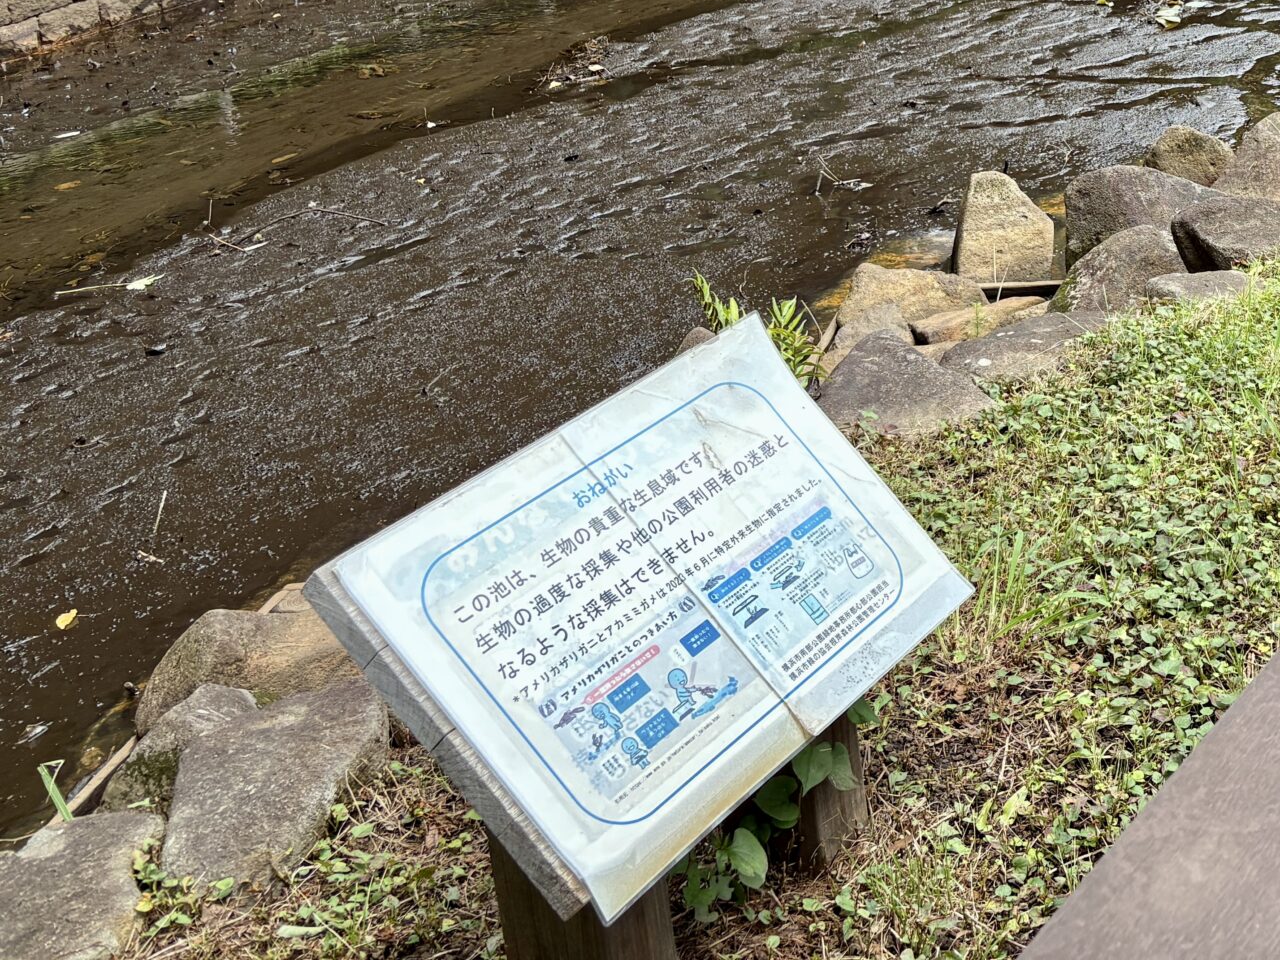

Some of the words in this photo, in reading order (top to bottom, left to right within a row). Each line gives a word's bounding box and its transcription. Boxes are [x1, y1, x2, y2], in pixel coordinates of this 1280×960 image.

[450, 445, 710, 630] この池は、生物の貴重な生息域です
[472, 428, 790, 659] 生物の過度な採集や他の公園利用者の迷惑と
[569, 459, 636, 510] おねがい
[494, 517, 715, 686] なるような採集はできません。
